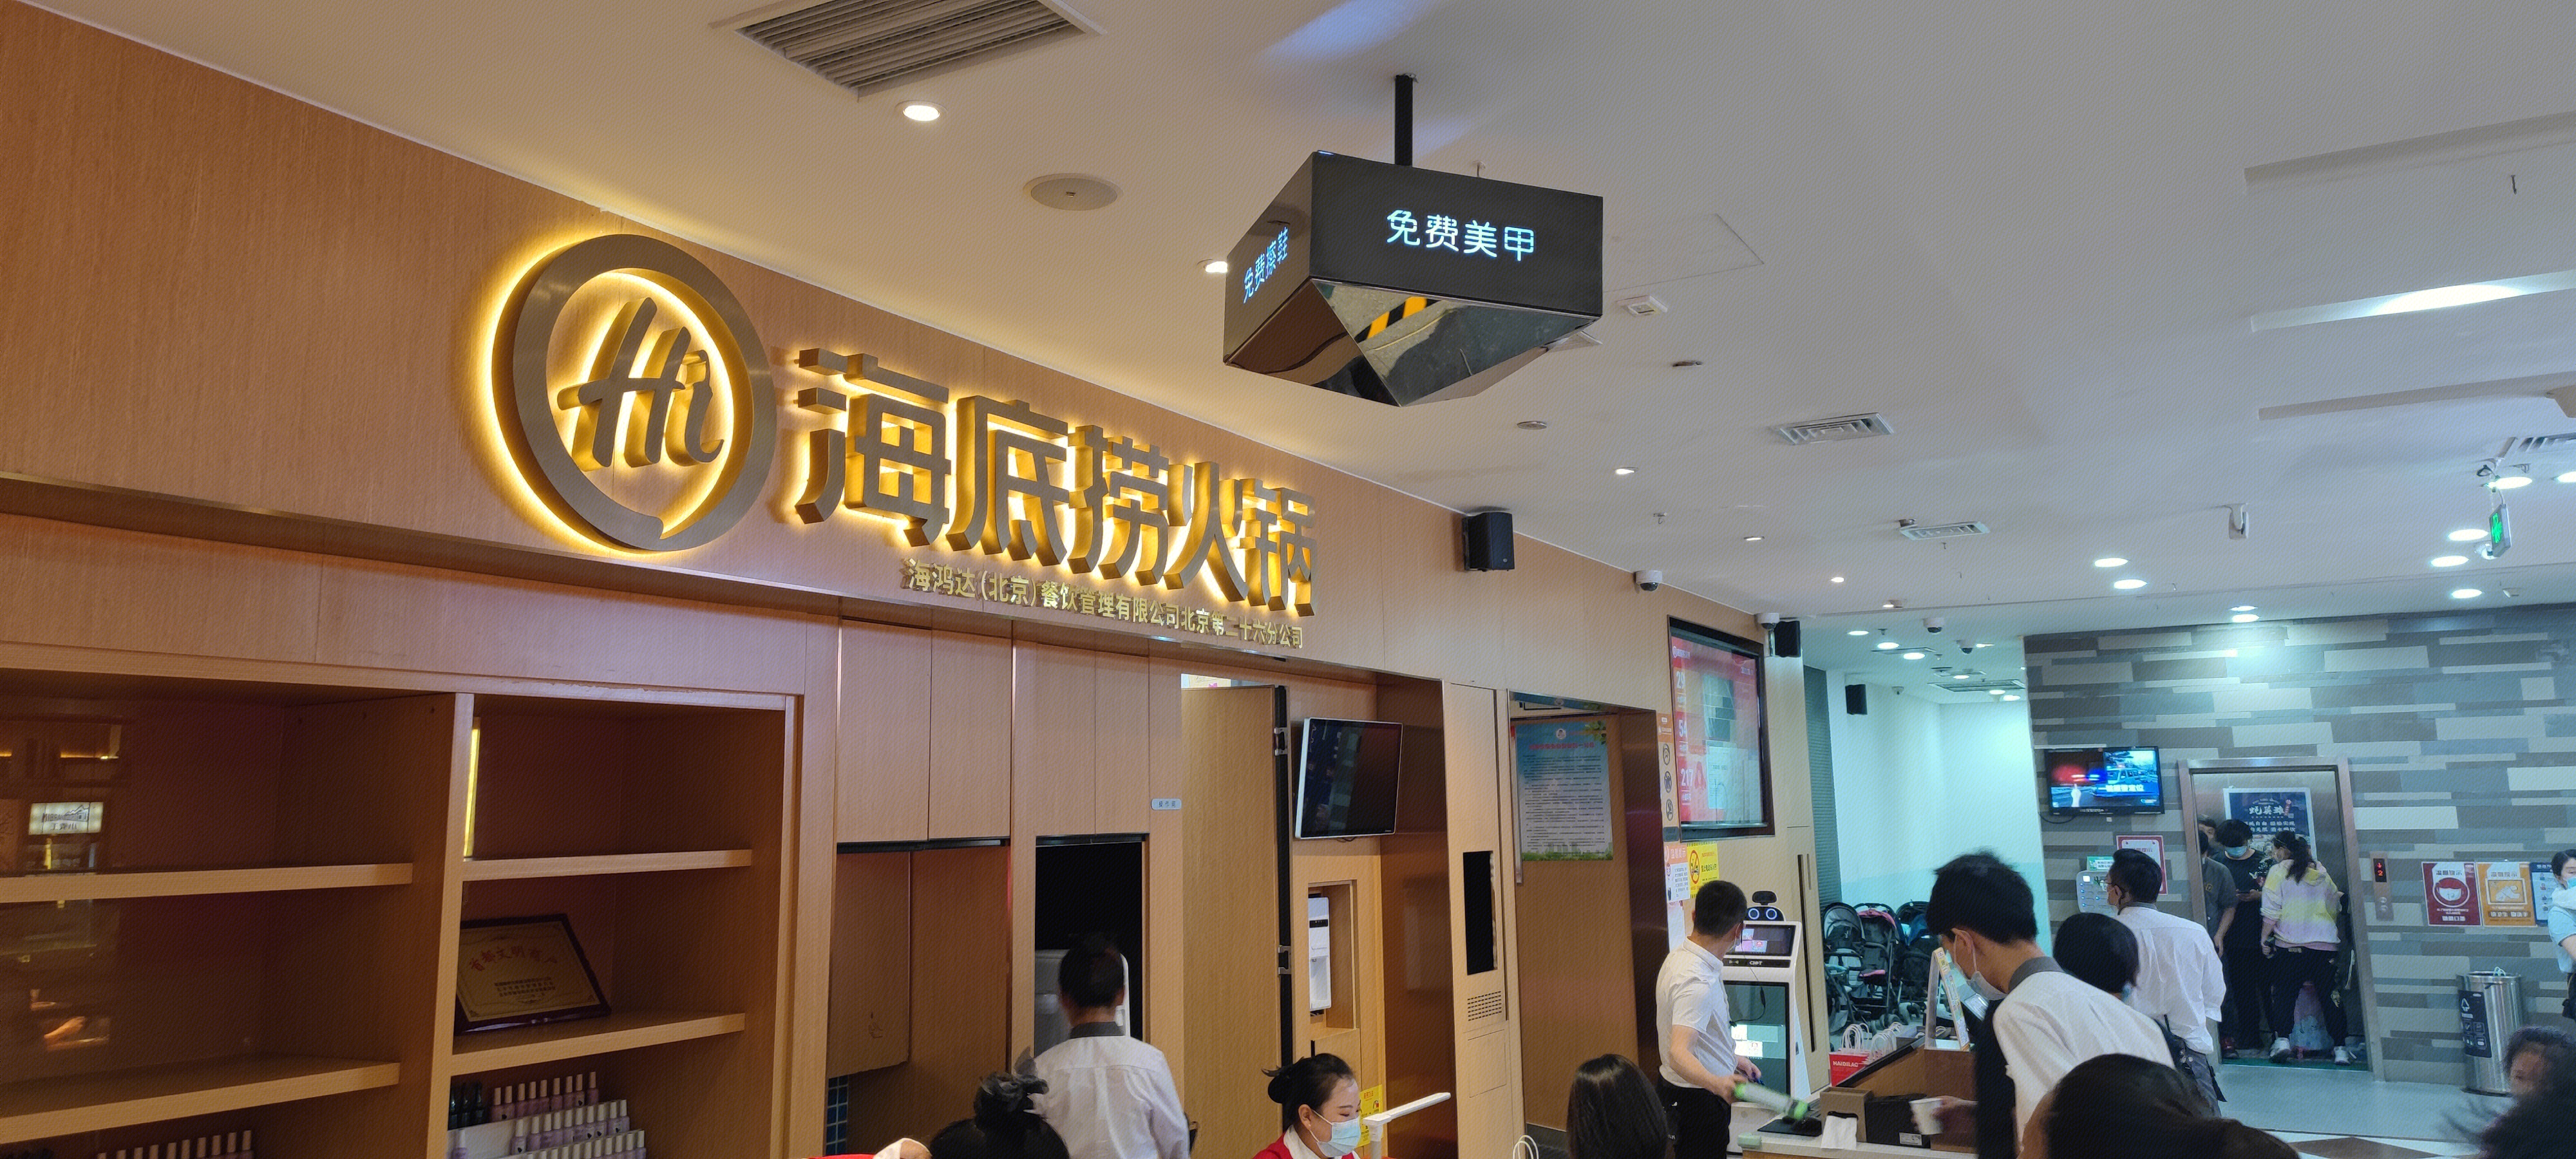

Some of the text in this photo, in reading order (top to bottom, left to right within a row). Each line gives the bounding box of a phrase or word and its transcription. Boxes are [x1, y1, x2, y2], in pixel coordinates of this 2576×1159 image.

[1387, 210, 1535, 261] 免费美甲
[795, 348, 1317, 616] 海底捞火锅
[1676, 671, 1685, 689] 29
[1681, 768, 1694, 786] 217
